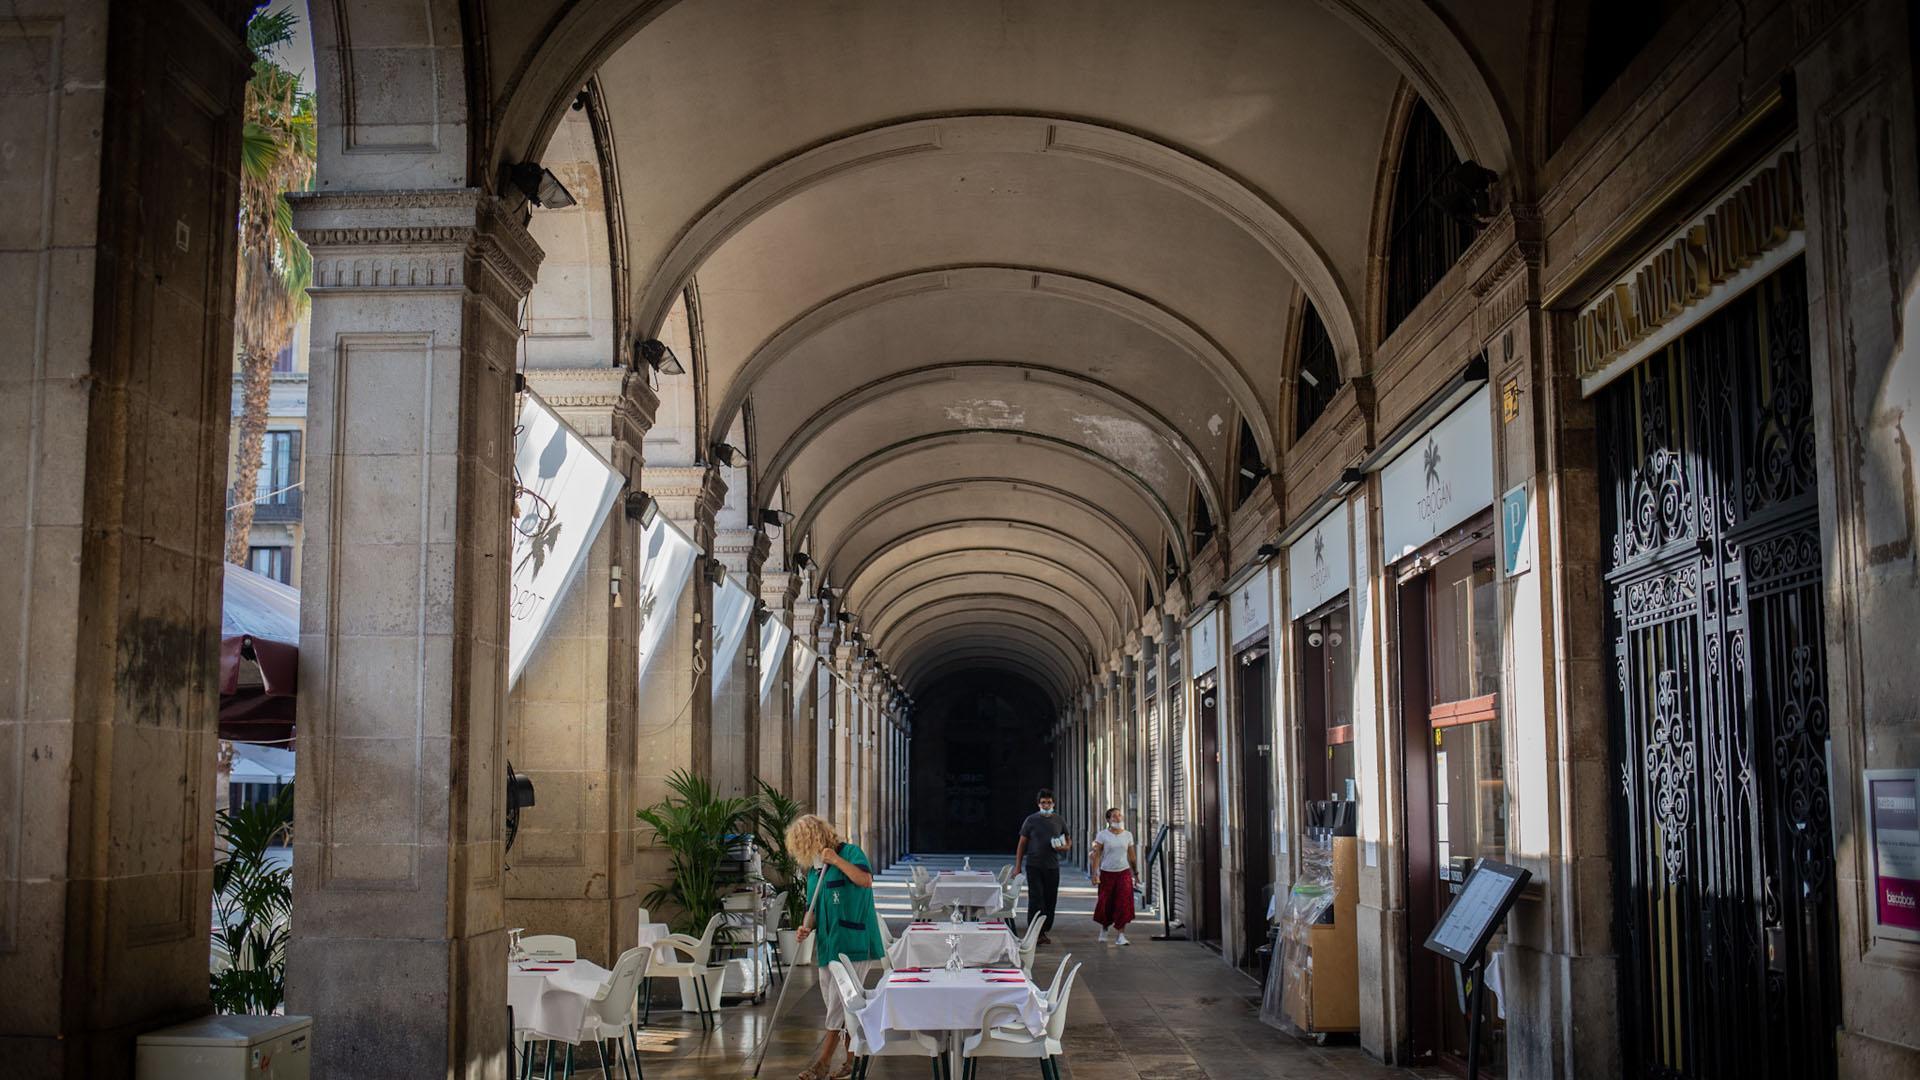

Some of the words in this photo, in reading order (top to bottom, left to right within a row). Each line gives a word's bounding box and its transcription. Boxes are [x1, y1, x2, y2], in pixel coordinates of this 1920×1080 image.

[1574, 284, 1633, 379] HOSTAL
[1634, 227, 1701, 335] AMBOS
[1510, 502, 1521, 543] P
